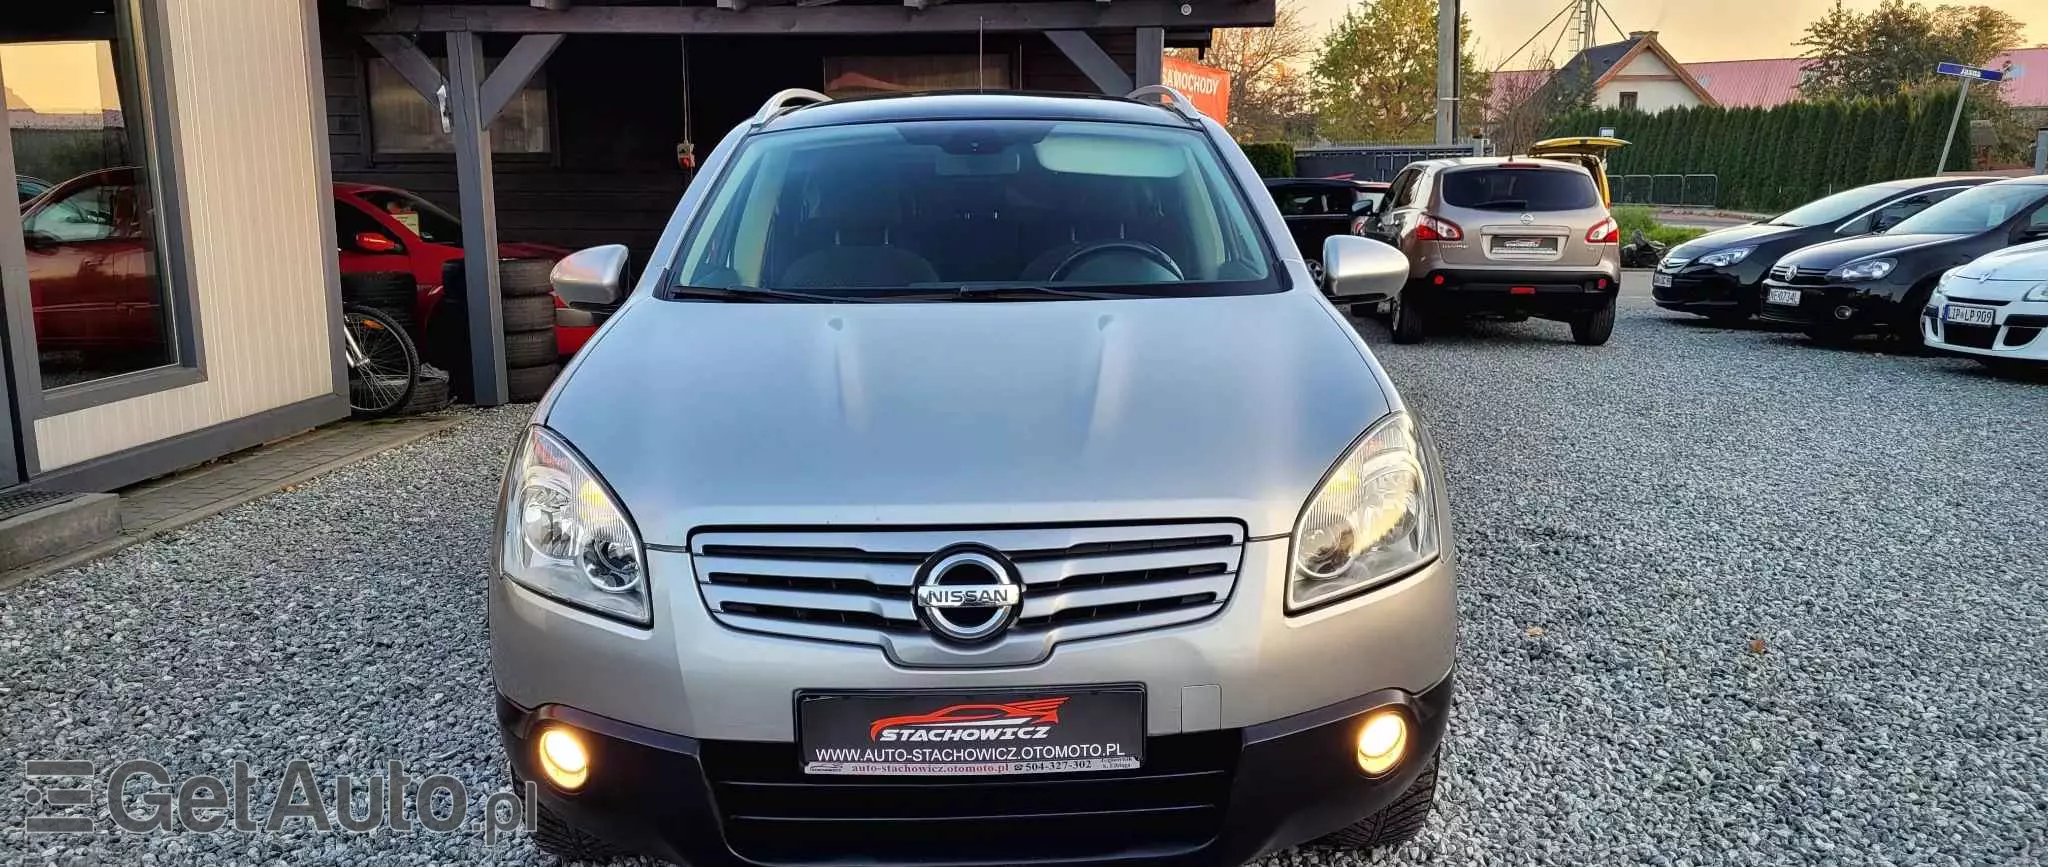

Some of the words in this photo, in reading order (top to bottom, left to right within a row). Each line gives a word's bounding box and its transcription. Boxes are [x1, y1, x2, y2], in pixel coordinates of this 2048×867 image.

[1976, 311, 1992, 323] 909
[928, 589, 1008, 603] NISSAN
[880, 726, 1051, 742] STACHOWICZ
[815, 743, 1126, 763] WWW.AUTO-STACHOWICZ.OTOMOTO.PL
[852, 761, 1009, 775] auto-stachowicz.otomoto.pl
[1025, 759, 1092, 771] 504-327-302
